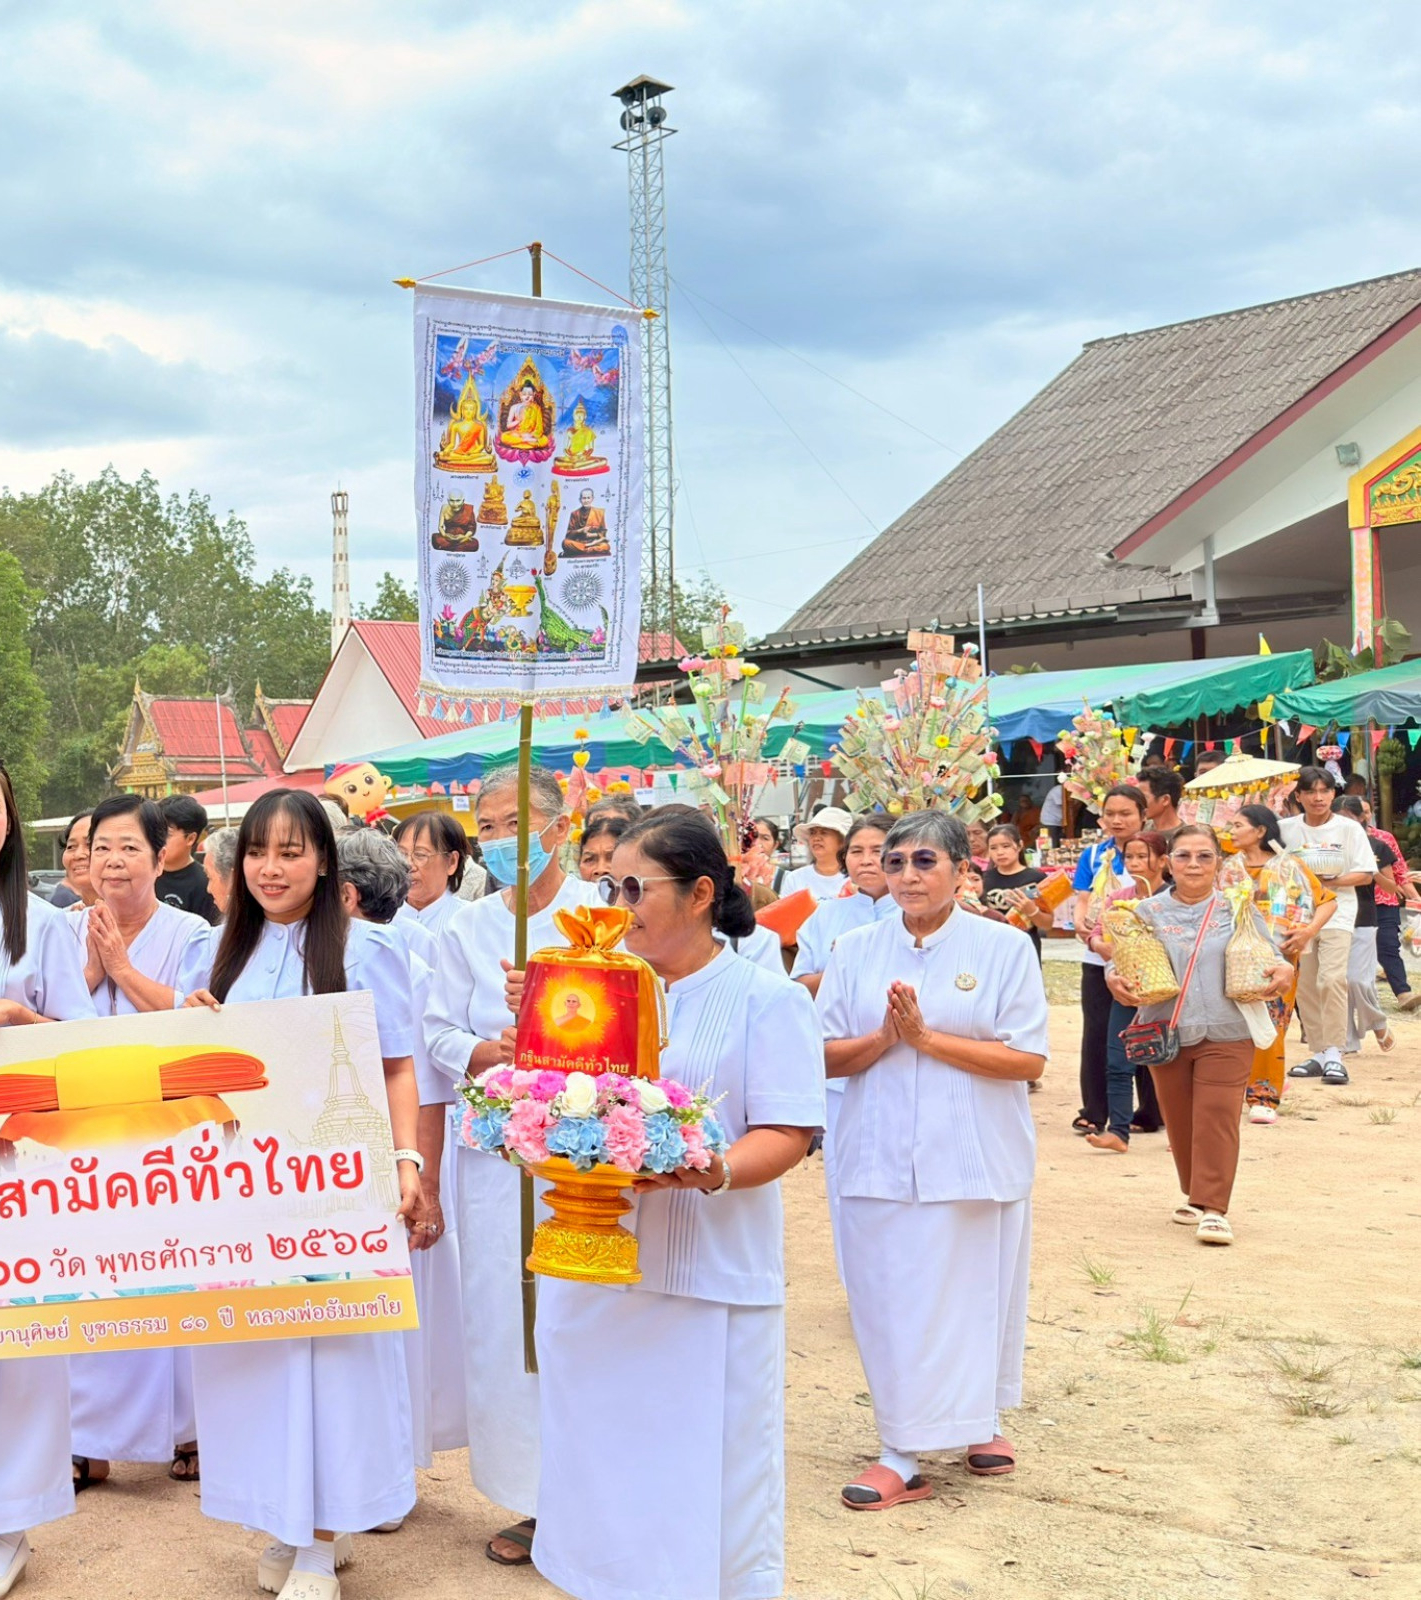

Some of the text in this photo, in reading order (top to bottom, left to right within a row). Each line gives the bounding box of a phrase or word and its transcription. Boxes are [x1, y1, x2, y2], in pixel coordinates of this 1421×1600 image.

[520, 1049, 630, 1074] กฐินสามัคคีทั่วไทย
[50, 1247, 86, 1278] วัด
[95, 1238, 254, 1284] พุทธศักราช
[266, 1223, 389, 1261] ๒๕๖๘
[81, 1316, 168, 1344] บูชาธรรม
[180, 1314, 209, 1331] ๘๑
[220, 1305, 235, 1328] ปี
[245, 1294, 402, 1328] หลวงพ่อธัมมชโย
